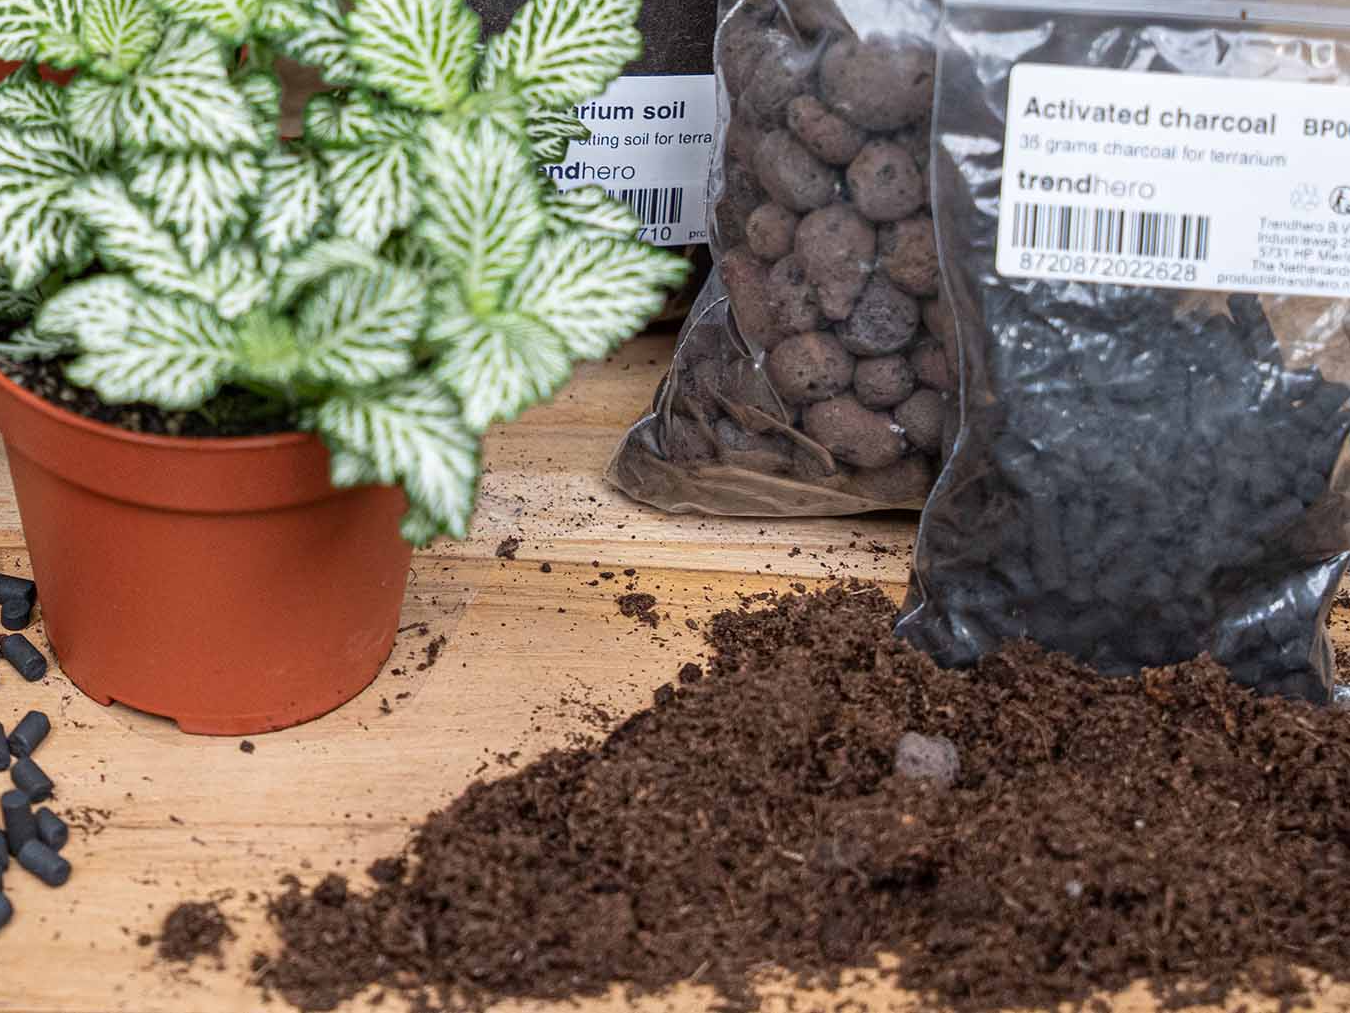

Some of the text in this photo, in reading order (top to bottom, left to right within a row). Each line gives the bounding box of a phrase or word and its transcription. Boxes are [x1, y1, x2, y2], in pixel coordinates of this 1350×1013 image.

[643, 101, 685, 119] soil
[1024, 96, 1350, 139] Activated charcoal BP0
[624, 132, 650, 146] soil
[654, 132, 673, 145] for
[679, 132, 712, 144] terra
[1045, 138, 1098, 155] grams
[1103, 141, 1176, 160] charcoal
[1182, 147, 1204, 161] for
[1210, 149, 1287, 167] terrarium
[1018, 170, 1155, 200] trendhero
[1019, 253, 1197, 282] 8720872022628
